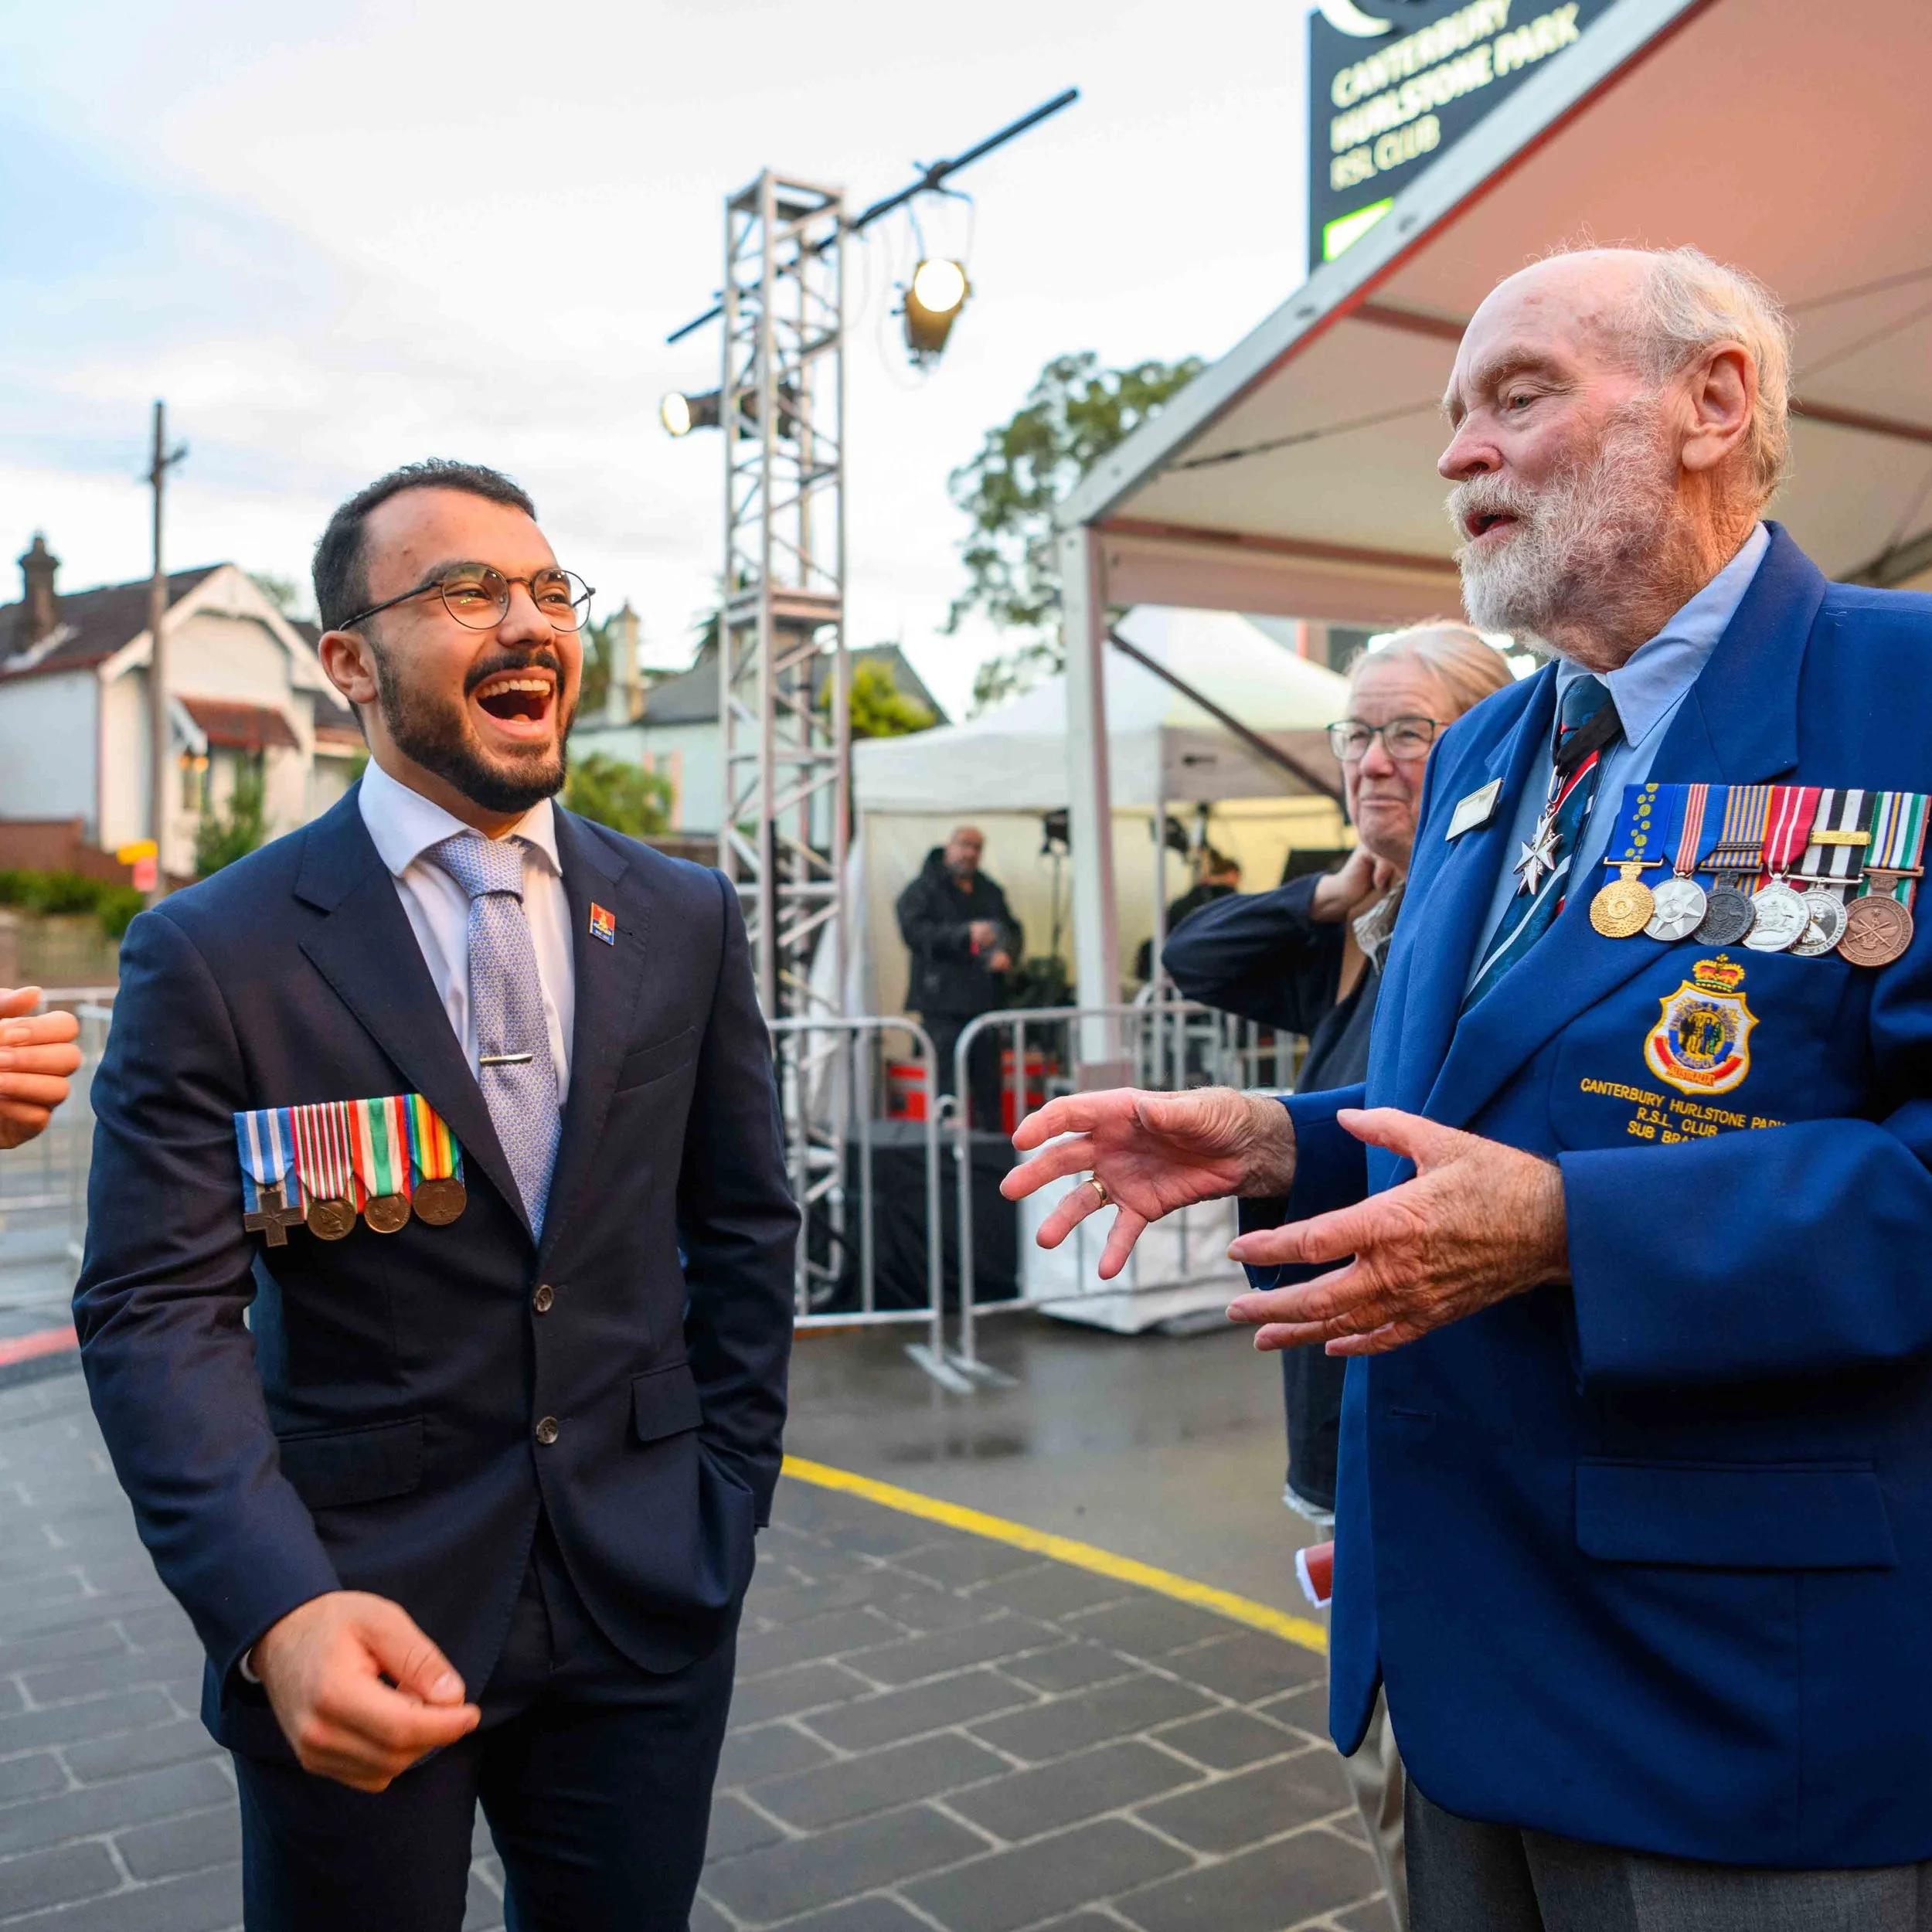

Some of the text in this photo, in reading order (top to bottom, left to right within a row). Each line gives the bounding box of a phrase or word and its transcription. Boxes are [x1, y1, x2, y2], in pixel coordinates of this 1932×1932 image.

[1331, 2, 1580, 153] HURLSTONE PARK
[1332, 0, 1512, 108] CANTERBURY
[1330, 114, 1440, 192] RSL CLUB
[1580, 1078, 1665, 1107] CANTERBURY
[1669, 1099, 1747, 1128] HURLSTONE
[1627, 1120, 1655, 1138] SUB
[1636, 1107, 1718, 1137] R.S.L. CLUB
